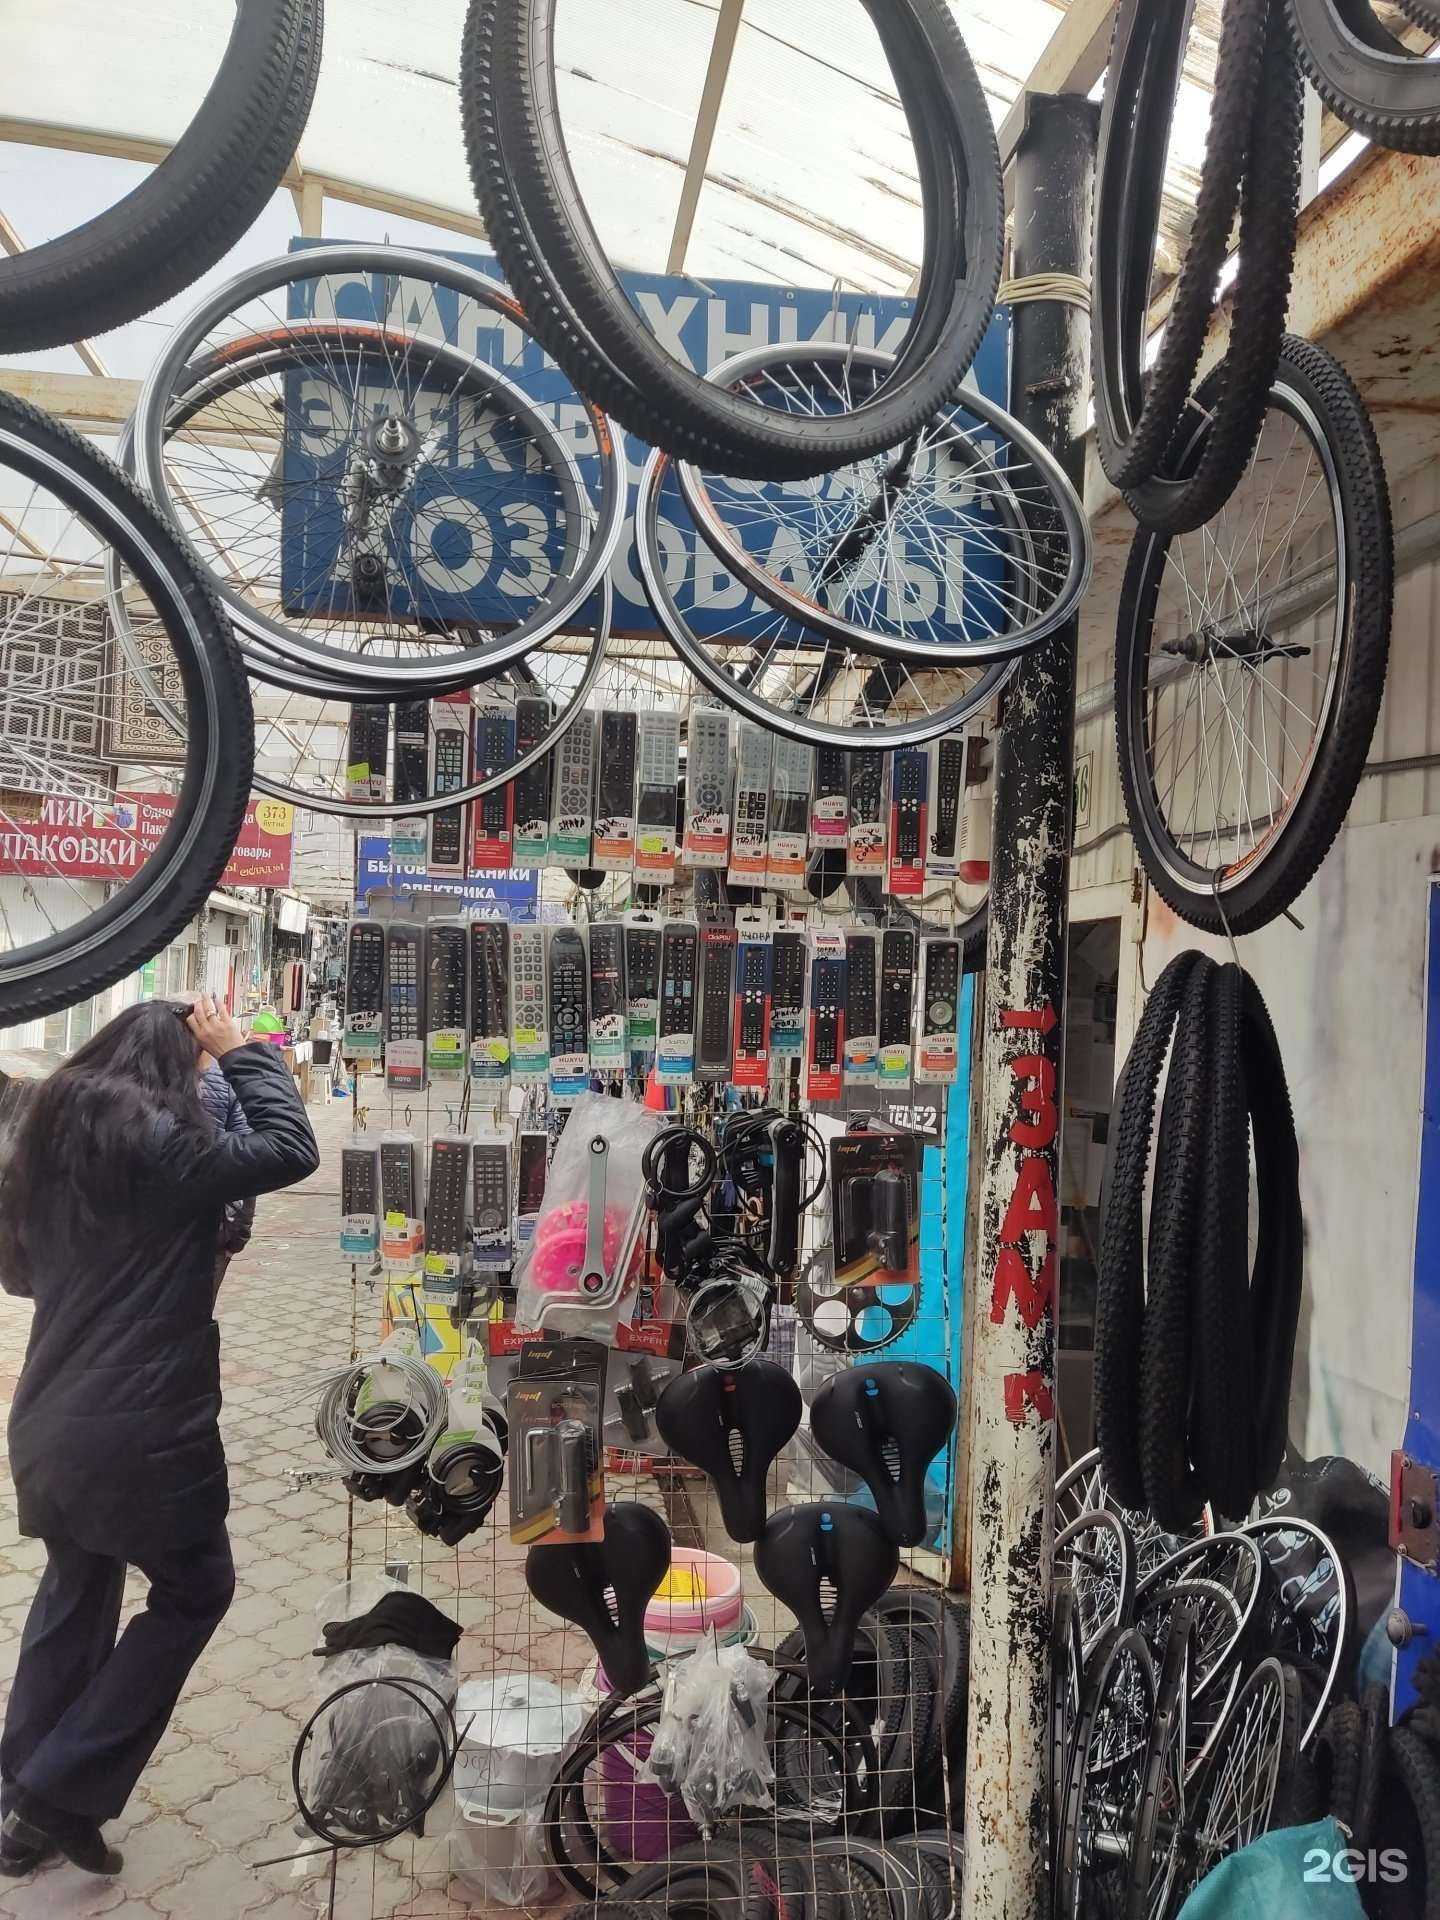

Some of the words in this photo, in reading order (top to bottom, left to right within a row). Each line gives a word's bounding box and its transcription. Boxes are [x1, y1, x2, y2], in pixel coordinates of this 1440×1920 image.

[37, 796, 96, 827] МИР
[263, 806, 286, 820] 373
[889, 1104, 938, 1135] TELE2
